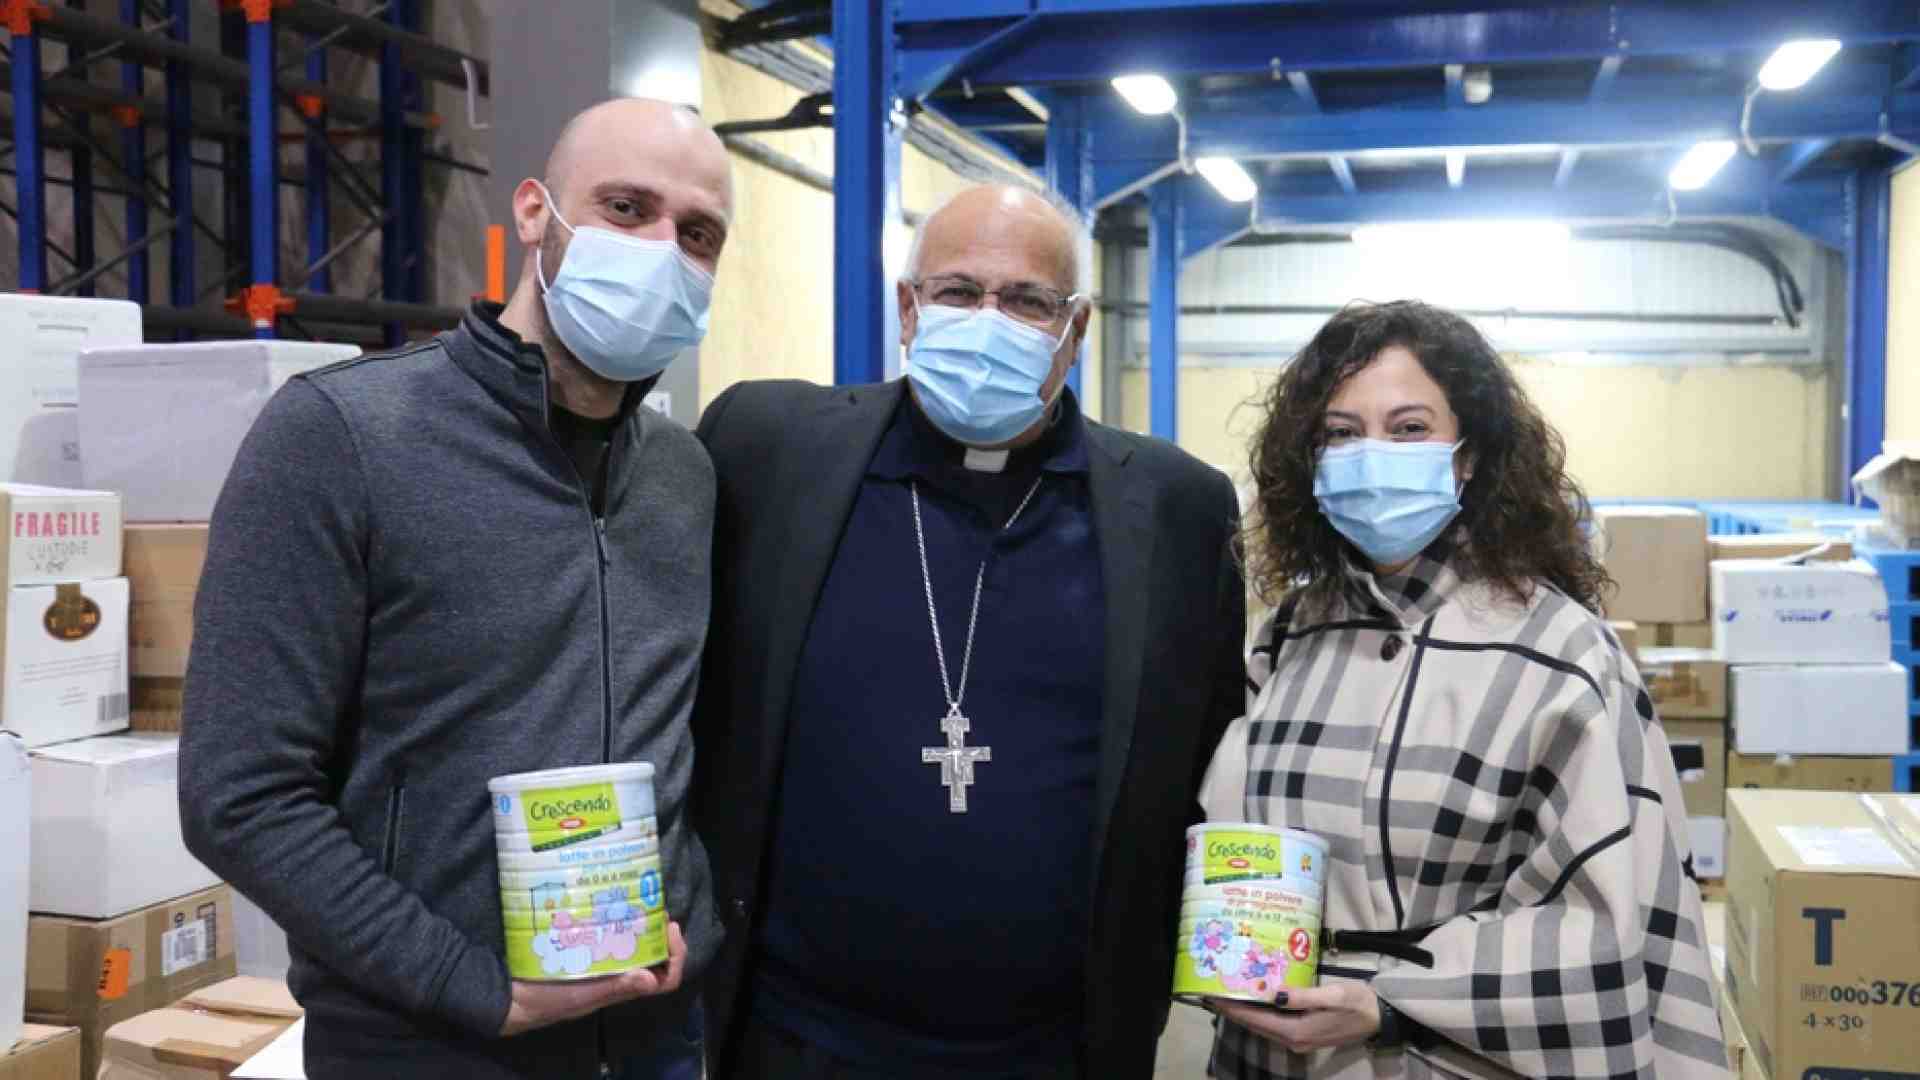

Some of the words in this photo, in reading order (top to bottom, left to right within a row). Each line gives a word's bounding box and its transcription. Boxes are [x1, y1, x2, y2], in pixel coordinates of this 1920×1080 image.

[15, 511, 100, 537] FRAGILE
[530, 794, 610, 821] Crescendo
[1207, 841, 1276, 861] Crescendo
[1295, 932, 1306, 959] 2
[1802, 907, 1846, 966] T
